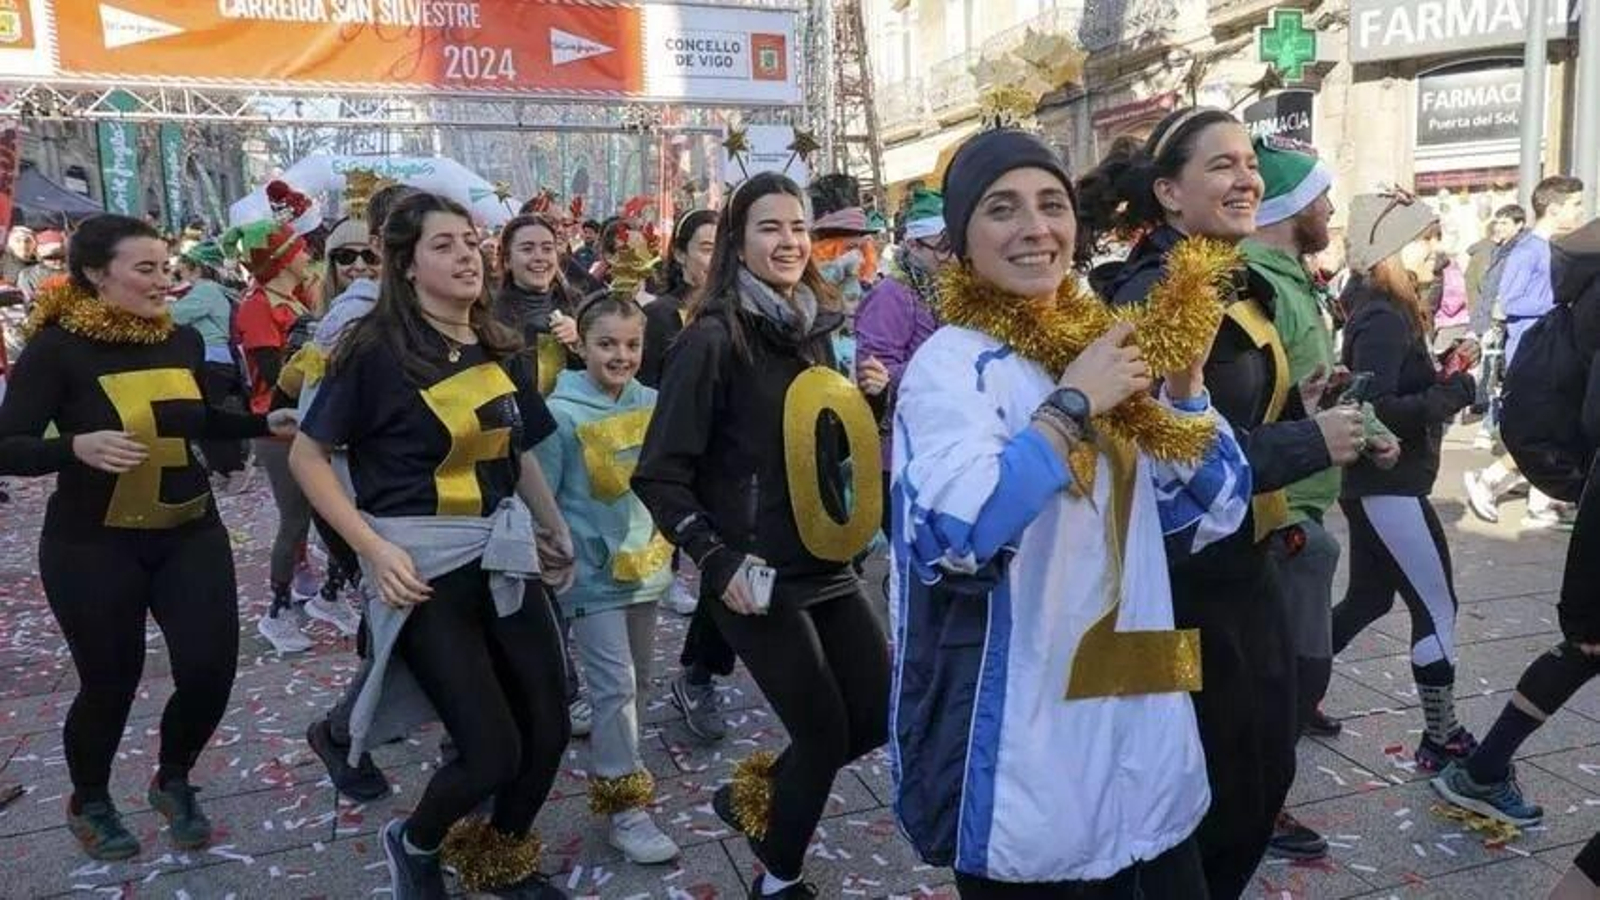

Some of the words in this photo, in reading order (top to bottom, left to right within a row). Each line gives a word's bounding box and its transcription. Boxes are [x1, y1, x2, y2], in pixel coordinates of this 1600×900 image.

[218, 0, 328, 22] CARREIRA
[331, 0, 374, 24] SAN
[379, 0, 482, 28] SILVESTRE
[1360, 0, 1581, 49] FARMAI
[665, 38, 741, 54] CONCELLO
[675, 54, 694, 67] DE
[698, 55, 734, 68] VIGO
[443, 45, 517, 81] 2024
[1473, 112, 1493, 127] del
[97, 368, 211, 529] E
[418, 361, 518, 517] F
